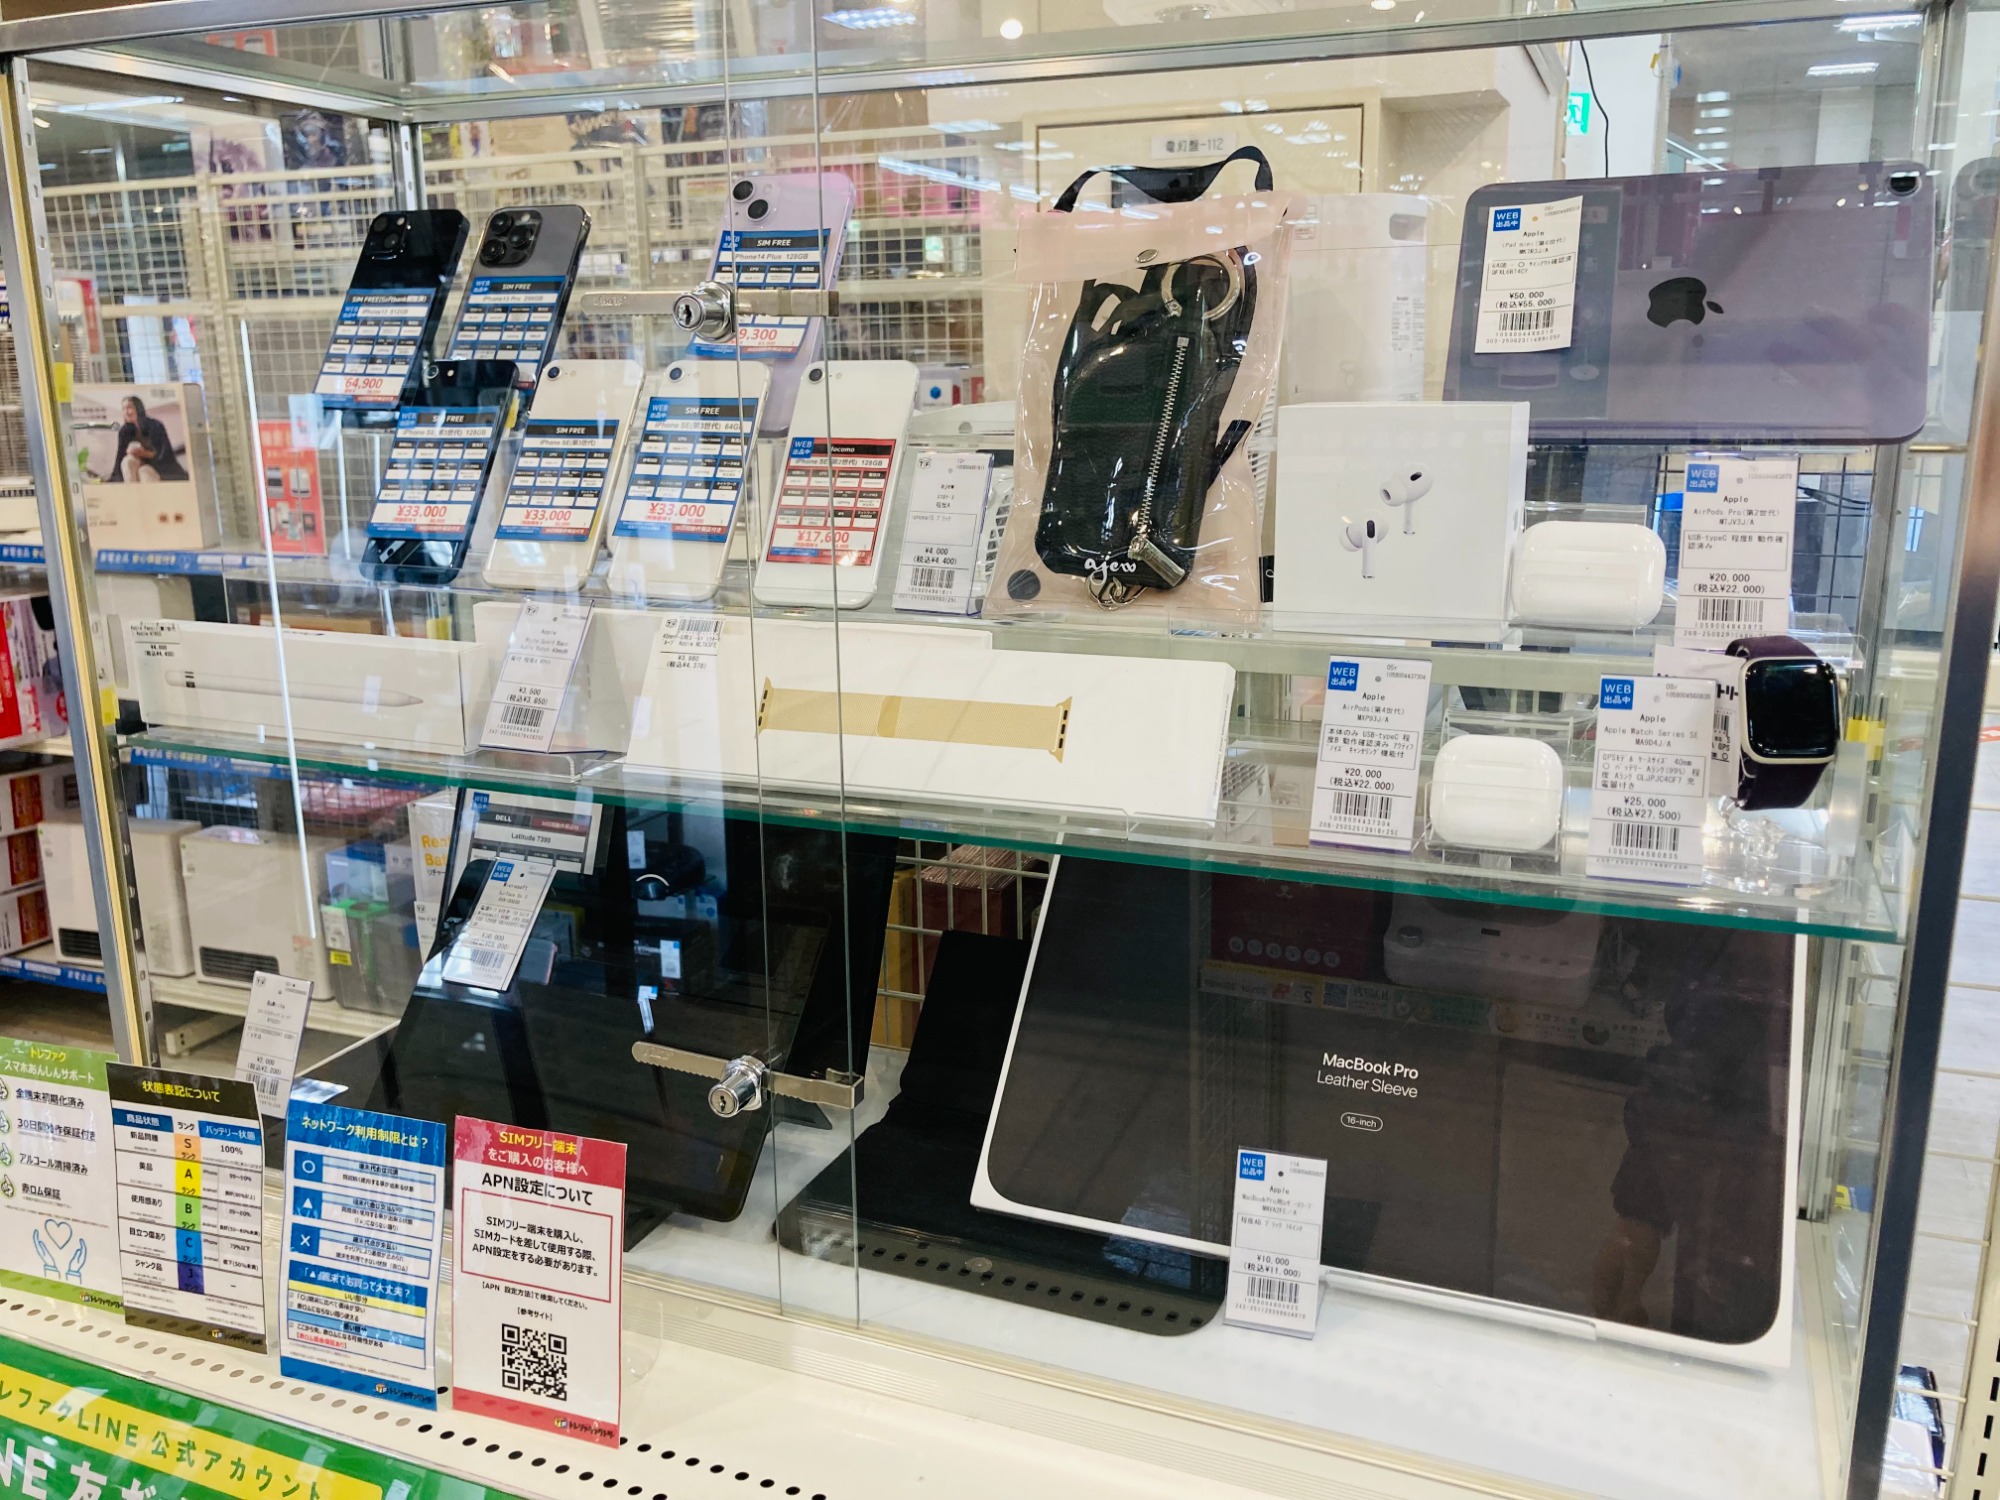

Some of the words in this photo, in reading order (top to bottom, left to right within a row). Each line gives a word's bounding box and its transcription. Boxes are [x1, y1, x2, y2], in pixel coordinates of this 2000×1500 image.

[1496, 212, 1519, 222] WEB
[1523, 231, 1545, 240] Apple
[772, 239, 791, 247] FREE
[685, 407, 699, 415] SIM
[446, 415, 464, 423] FREE
[795, 441, 812, 449] WEB
[861, 459, 883, 467] 128GB
[1690, 469, 1717, 479] WEB
[1723, 495, 1748, 504] Apple
[397, 505, 447, 517] ¥33,000
[525, 509, 571, 521] ¥33,000
[649, 502, 706, 517] ¥33,000
[1693, 508, 1724, 517] AirPods
[1687, 534, 1727, 542] USB-typeC
[1332, 666, 1357, 677] WEB
[1605, 683, 1631, 694] WEB
[1362, 691, 1385, 702] Apple
[1639, 713, 1666, 724] Apple
[1328, 727, 1360, 738] 本体のみ
[1362, 730, 1400, 741] USB-typeC
[1603, 726, 1627, 736] Apple
[1630, 727, 1655, 737] Watch
[1657, 728, 1686, 738] Series
[495, 813, 512, 823] DELL
[511, 832, 536, 842] Latitude
[496, 864, 512, 872] WEB
[31, 1046, 67, 1063] トレファク
[4, 1059, 95, 1084] スマホあんしんサポート
[1322, 1052, 1391, 1076] MacBook
[1393, 1063, 1419, 1080] Pro
[1317, 1069, 1368, 1091] Leather
[1371, 1078, 1418, 1098] Sleeve
[143, 1080, 221, 1103] 状態表記について
[16, 1087, 86, 1109] 全端末初期化済み
[126, 1113, 161, 1127] 商品状態
[1346, 1115, 1377, 1128] 16-inch
[177, 1121, 196, 1132] ランク
[302, 1115, 429, 1149] ネットワーク利用制限とは？
[205, 1125, 257, 1142] バッテリー状態
[184, 1137, 192, 1149] S
[499, 1131, 578, 1156] SIMフリー端末
[182, 1152, 197, 1161] ランク
[220, 1145, 244, 1157] 100%
[20, 1153, 89, 1175] アルコール清掃済み
[139, 1161, 154, 1172] 美品
[488, 1146, 589, 1177] をご購入のお客様へ
[1243, 1157, 1265, 1167] WEB
[184, 1168, 194, 1180] A
[22, 1182, 62, 1201] 赤ロム保証
[182, 1186, 197, 1196] ランク
[481, 1172, 593, 1207] APN設定について
[1269, 1185, 1290, 1195] Apple
[131, 1194, 163, 1208] 使用感あり
[185, 1203, 193, 1214] B
[182, 1220, 197, 1230] ランク
[486, 1215, 584, 1244] SIMフリー端末を購入し、
[129, 1227, 166, 1242] 目立つ傷あり
[185, 1237, 193, 1248] C
[473, 1228, 597, 1262] SIMカードを差して使用する際、
[135, 1258, 163, 1272] ジャンク品
[472, 1243, 599, 1278] APN設定をする必要があります。
[151, 1430, 322, 1499] 公式アカウント
